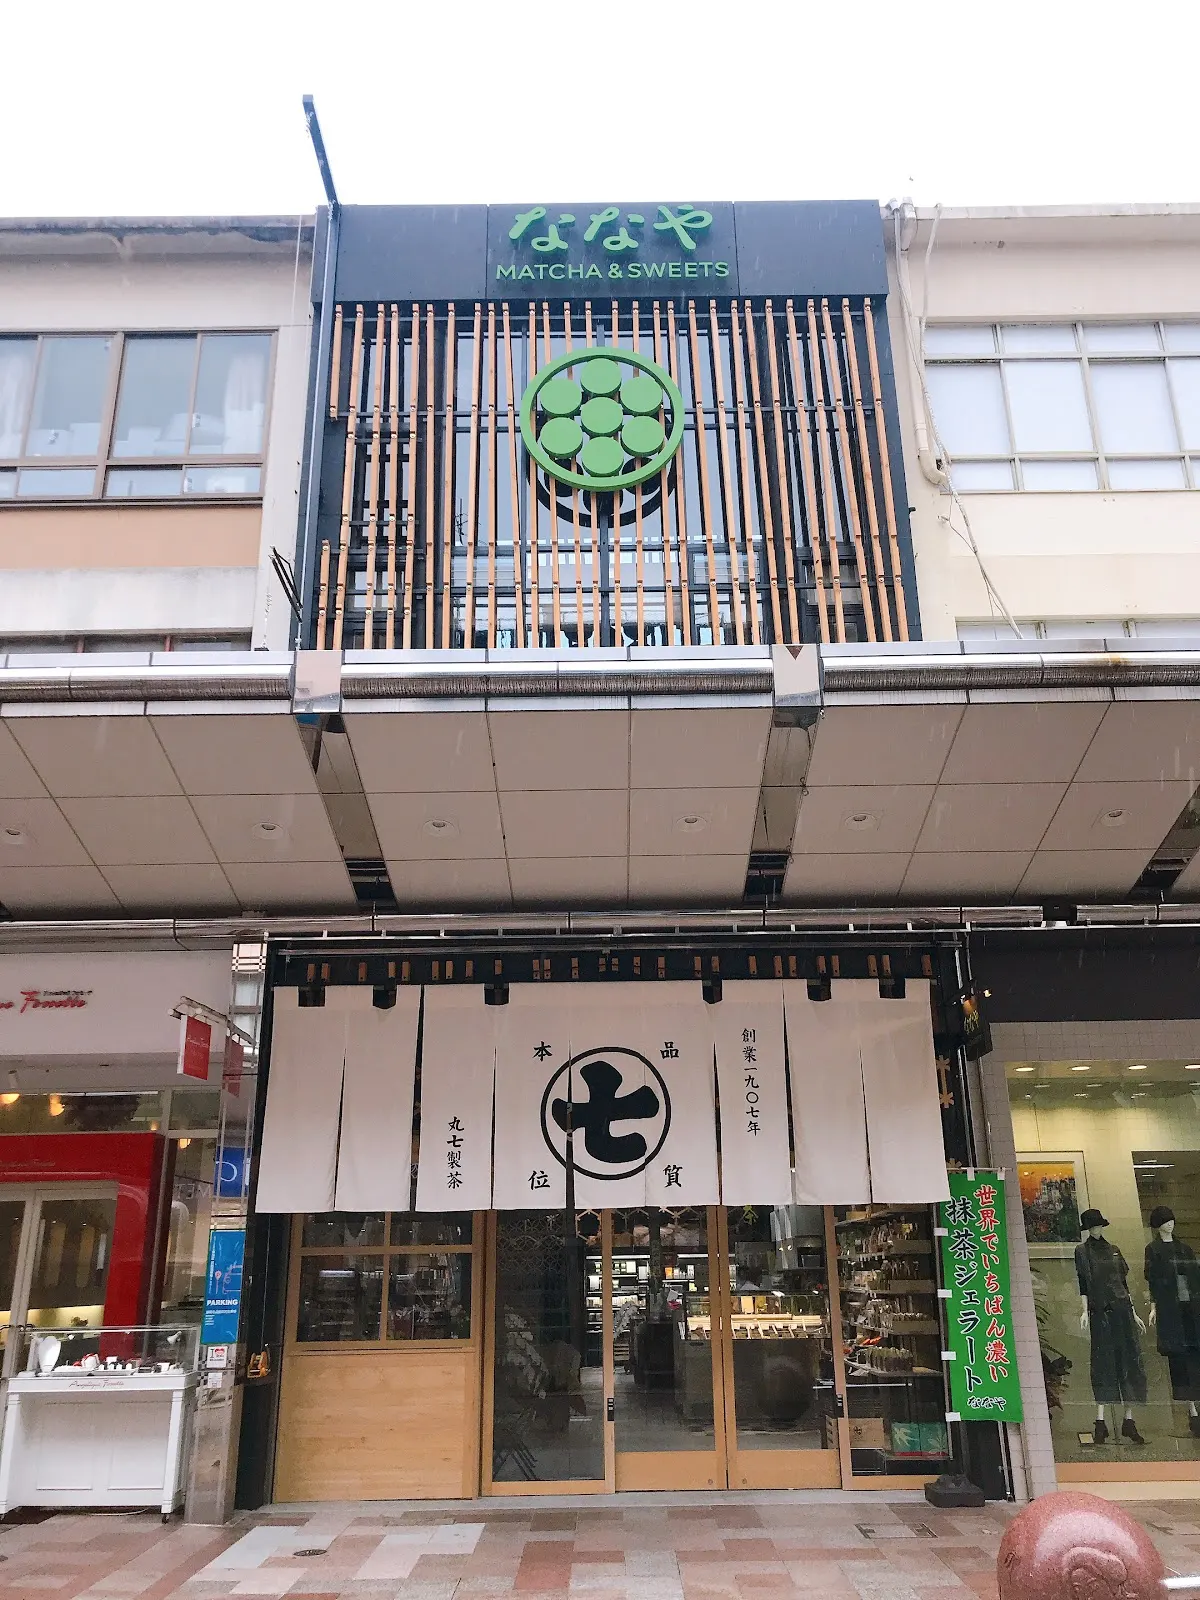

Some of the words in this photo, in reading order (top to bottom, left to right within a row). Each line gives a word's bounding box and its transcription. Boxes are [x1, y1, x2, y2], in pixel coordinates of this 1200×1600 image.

[508, 204, 713, 254] ななや
[495, 263, 602, 280] MATCHA
[608, 263, 623, 279] &
[627, 261, 730, 279] SWEETS
[446, 1115, 465, 1190] 丸七製茶
[945, 1196, 983, 1393] 抹茶ジェラート
[974, 1184, 1010, 1383] 世界でいちばん濃い
[966, 1396, 1006, 1412] ななや
